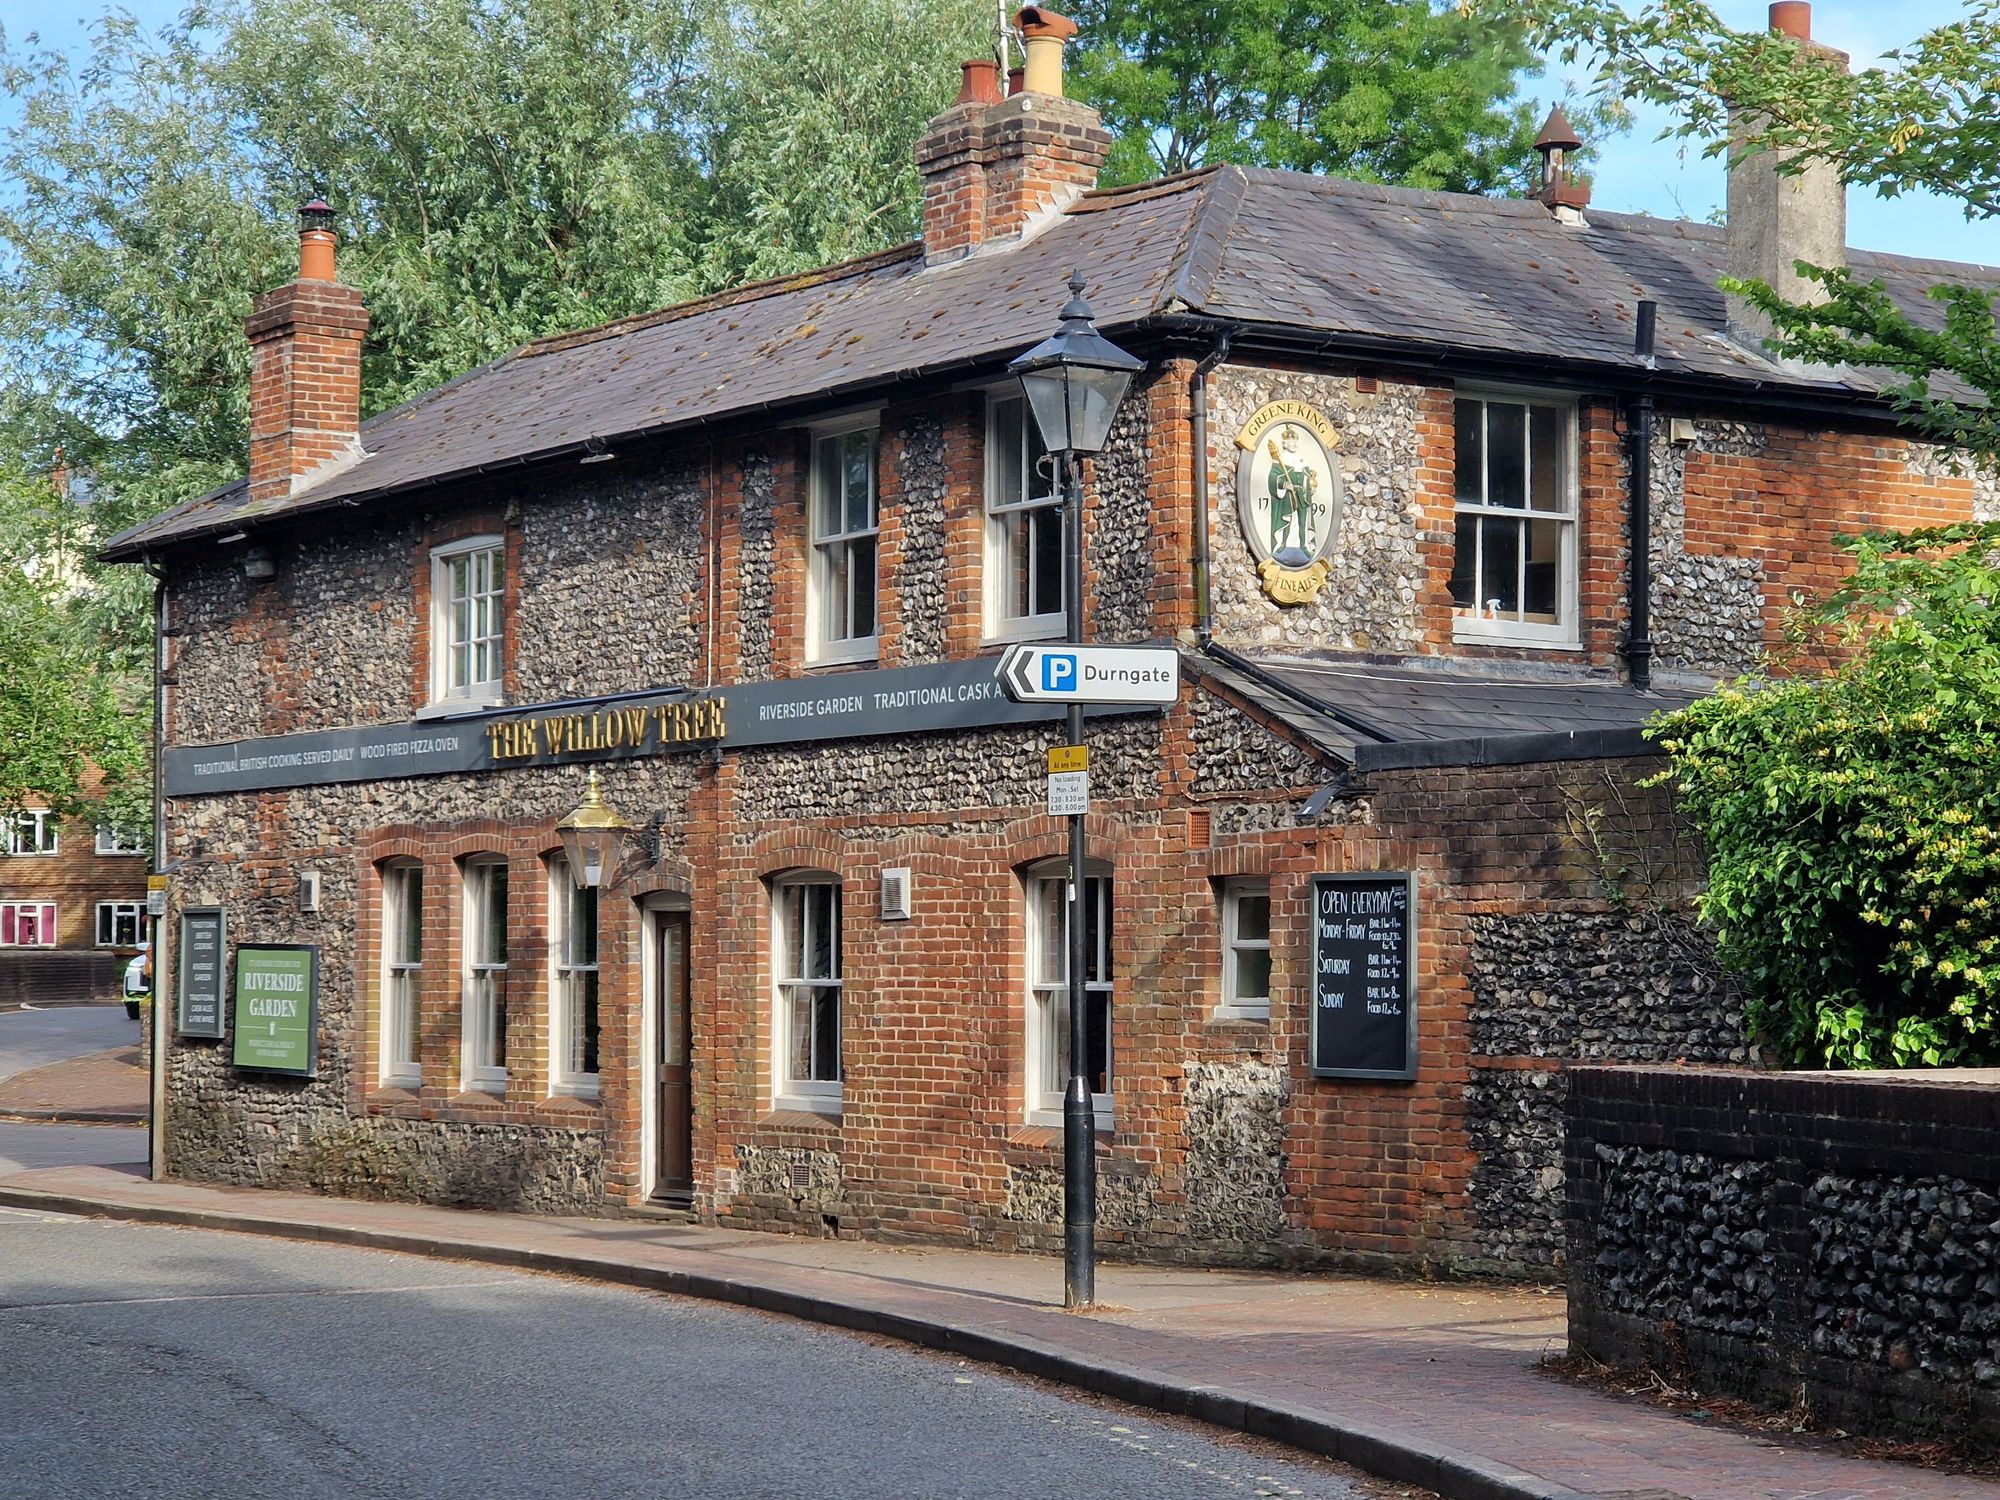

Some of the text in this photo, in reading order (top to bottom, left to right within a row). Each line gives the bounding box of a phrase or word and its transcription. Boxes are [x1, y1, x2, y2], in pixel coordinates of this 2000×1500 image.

[1248, 403, 1328, 436] GREENE KING
[1259, 497, 1269, 511] 17
[1085, 665, 1170, 685] Durngate
[759, 695, 863, 721] RIVERSIDE GARDEN
[874, 686, 955, 710] TRADITIONAL
[958, 682, 991, 702] CASK
[486, 696, 729, 759] THE WILLOW TREE
[360, 736, 459, 759] WOOD FIRED PIZZA OVEN
[193, 747, 355, 776] TRADITIONAL BRITISH COOKING SERVED DAILY
[1063, 775, 1081, 783] loading
[1321, 890, 1348, 914] OPEN
[1351, 887, 1394, 914] EVERYDAY
[244, 972, 304, 992] RIVERSIDE
[249, 998, 297, 1018] GARDEN
